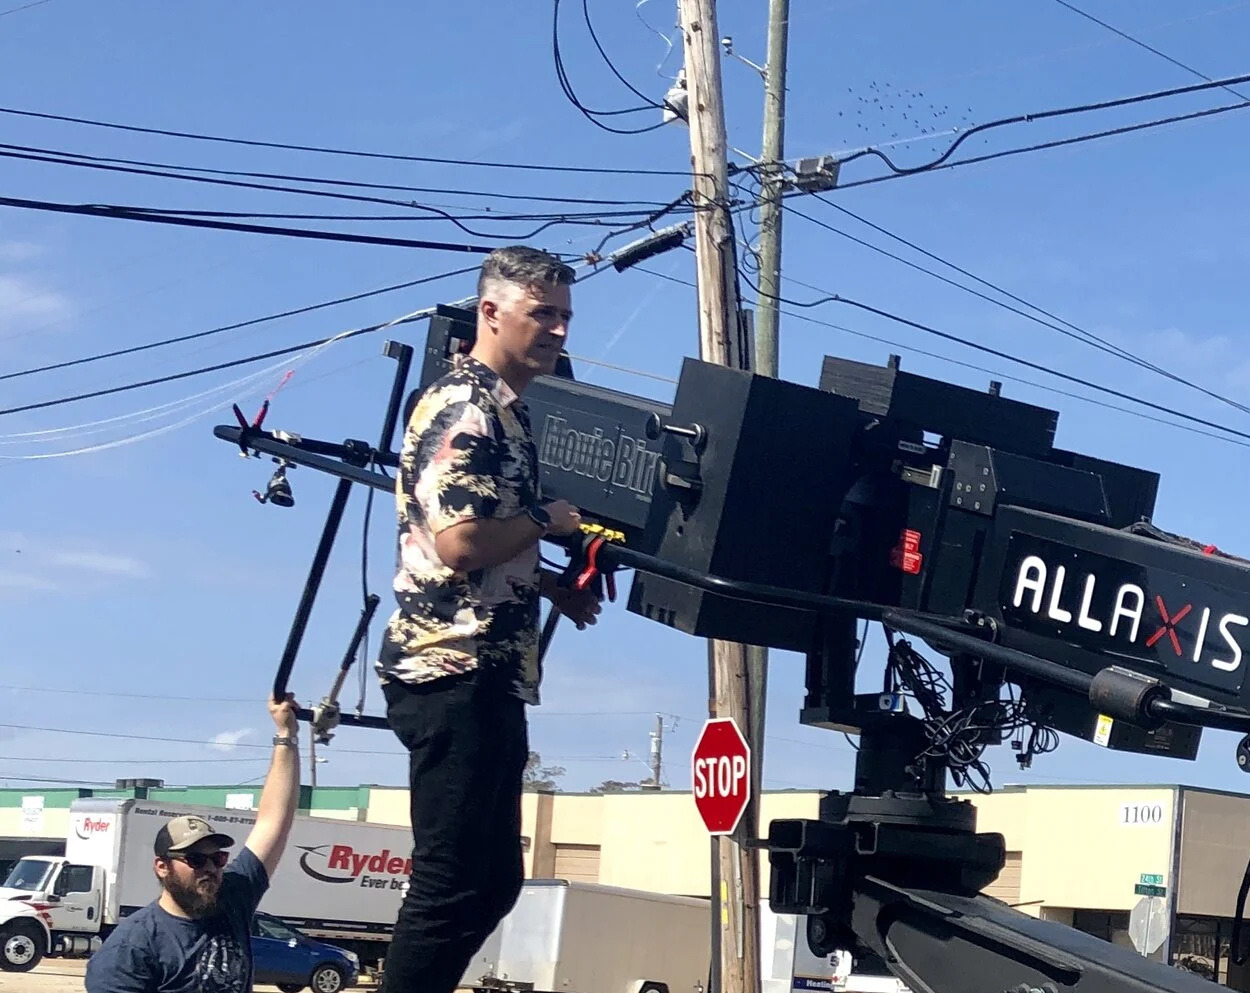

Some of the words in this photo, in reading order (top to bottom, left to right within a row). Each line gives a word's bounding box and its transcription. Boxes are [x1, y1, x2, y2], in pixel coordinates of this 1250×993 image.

[539, 414, 664, 497] MovieBir
[1013, 555, 1249, 672] ALLAXIS
[695, 755, 746, 799] STOP
[83, 817, 110, 833] Ryder
[1123, 805, 1162, 824] 1100
[360, 875, 389, 889] Ever
